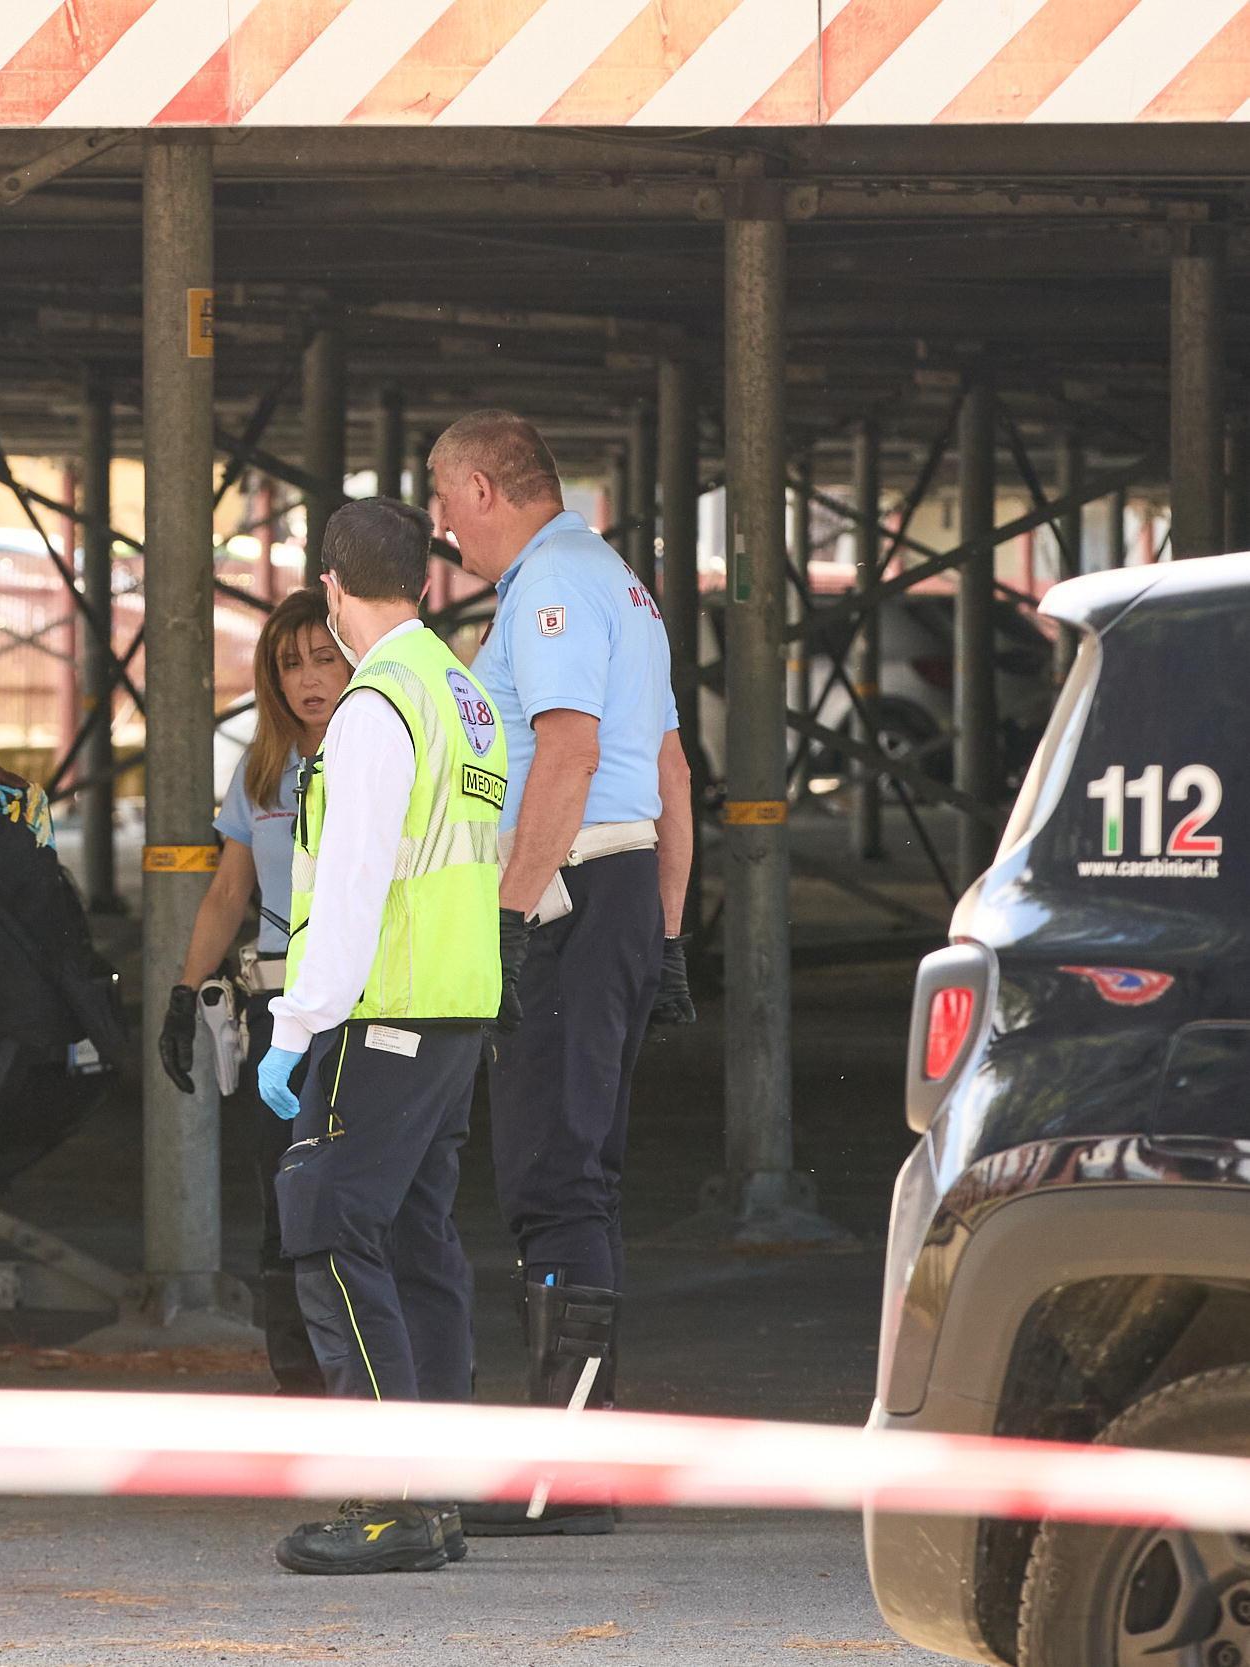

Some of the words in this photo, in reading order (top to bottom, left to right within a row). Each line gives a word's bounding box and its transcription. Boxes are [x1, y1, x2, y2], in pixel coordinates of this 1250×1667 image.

[466, 771, 504, 802] MEDICO
[1087, 764, 1223, 857] 112
[1078, 858, 1220, 878] www.carabinieri.it
